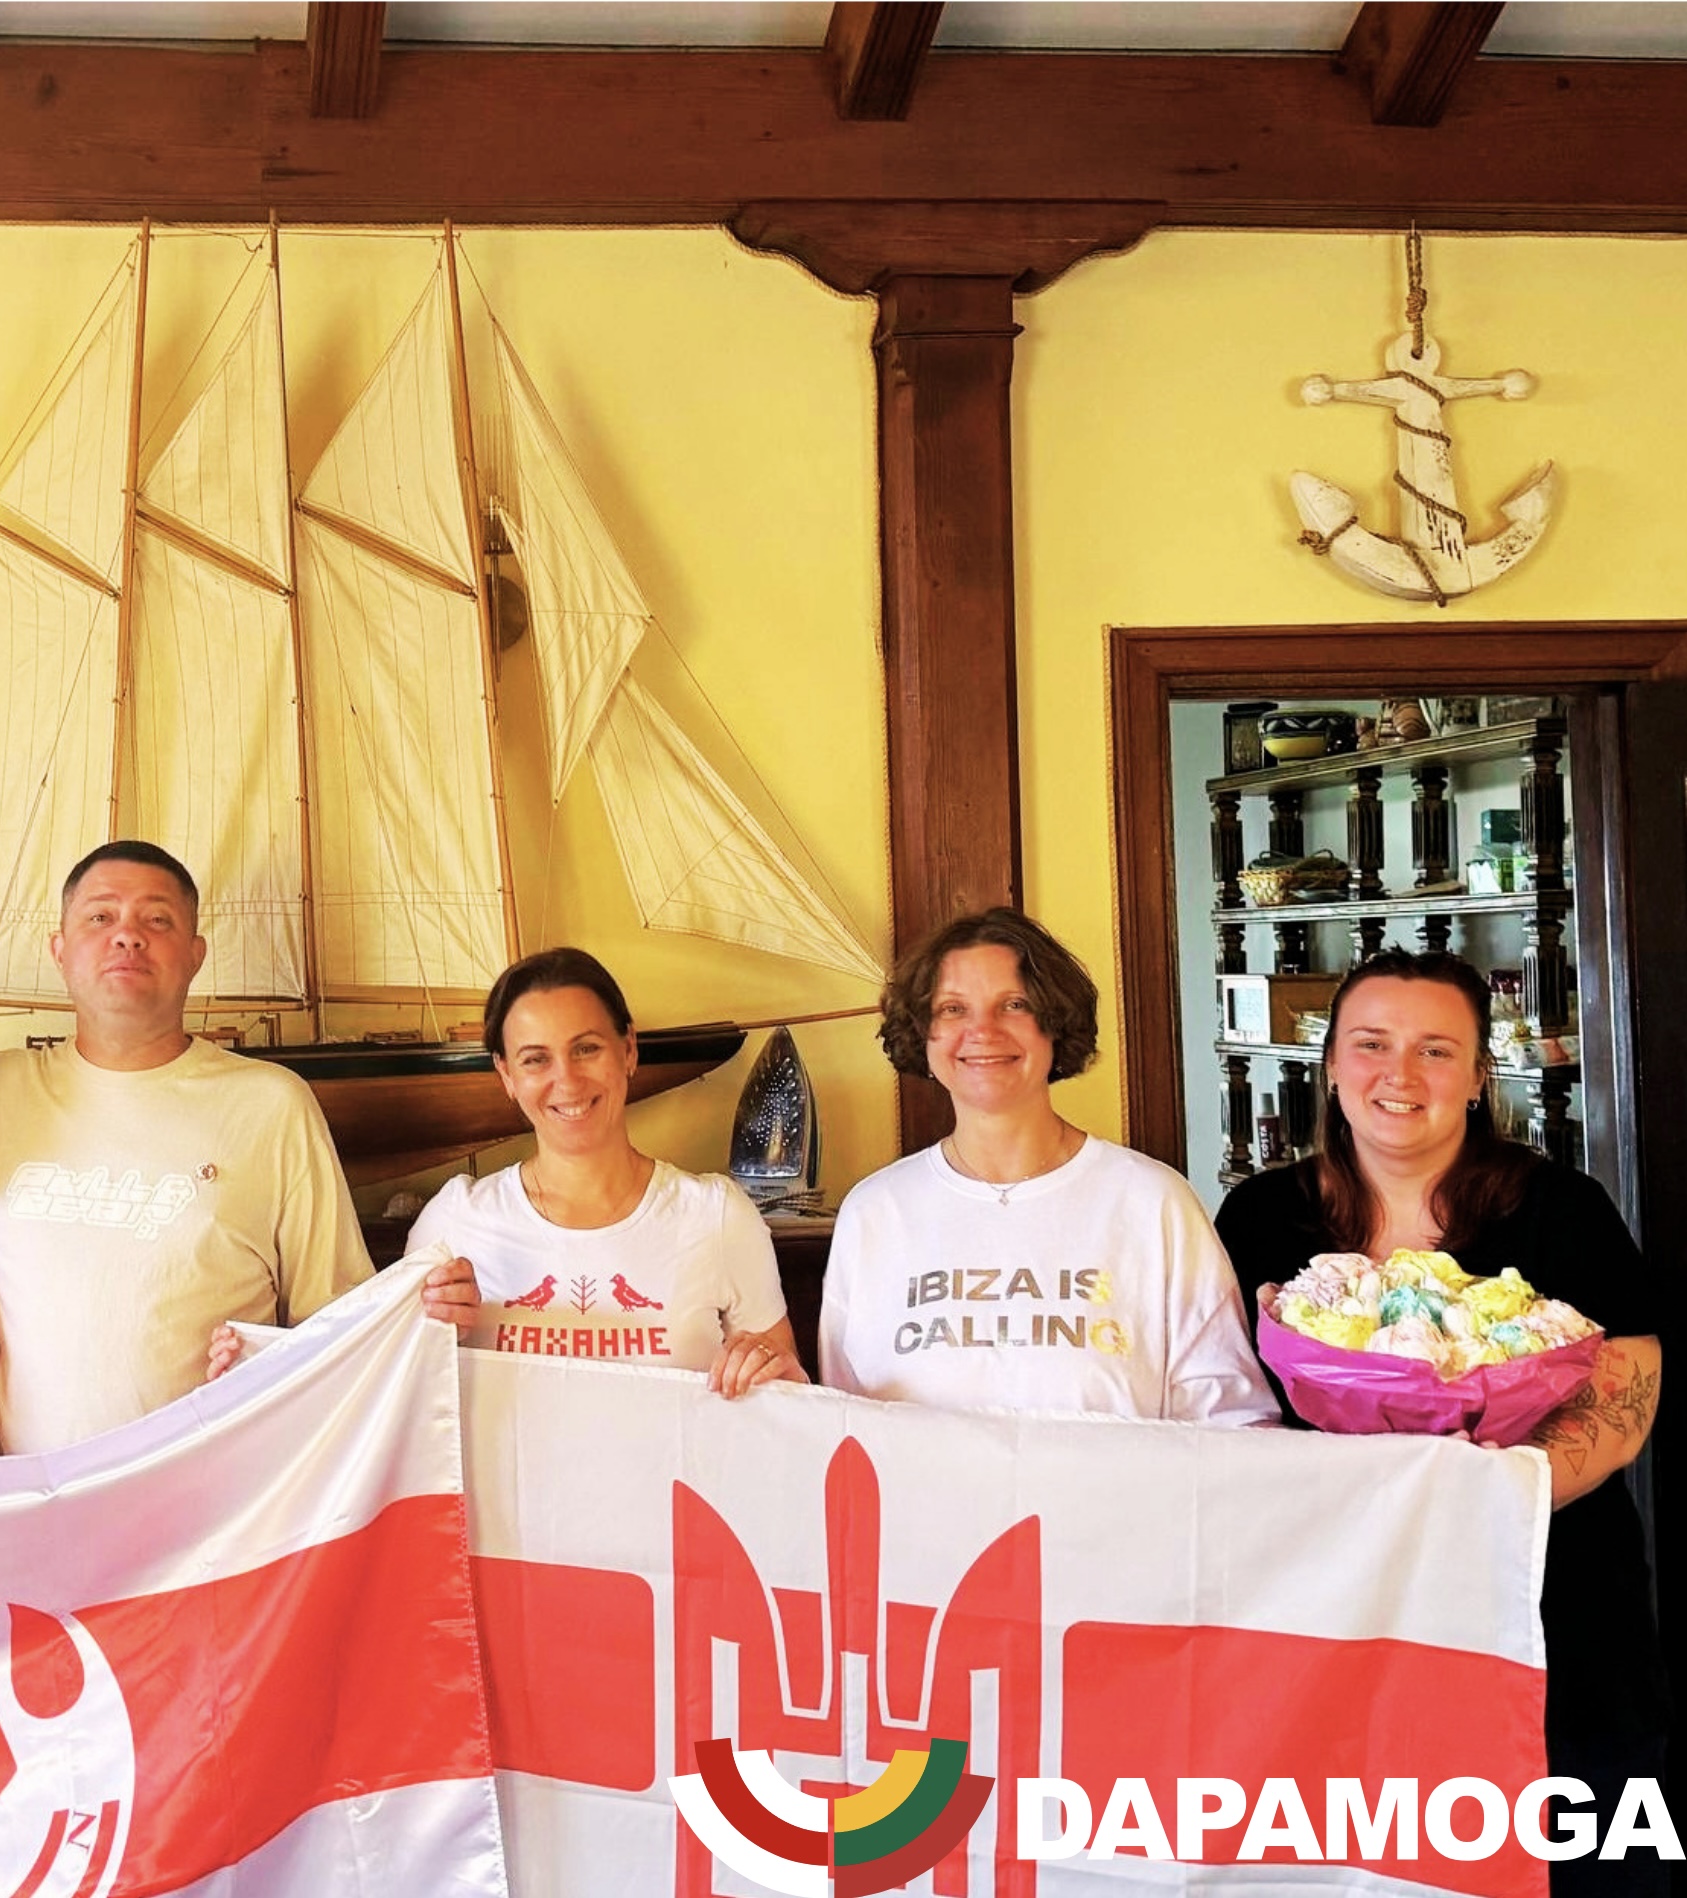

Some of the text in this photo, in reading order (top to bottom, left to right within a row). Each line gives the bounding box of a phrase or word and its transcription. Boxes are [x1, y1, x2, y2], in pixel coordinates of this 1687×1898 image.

[907, 1268, 1111, 1308] IBIZA IS
[496, 1323, 672, 1357] КАХАННЕ
